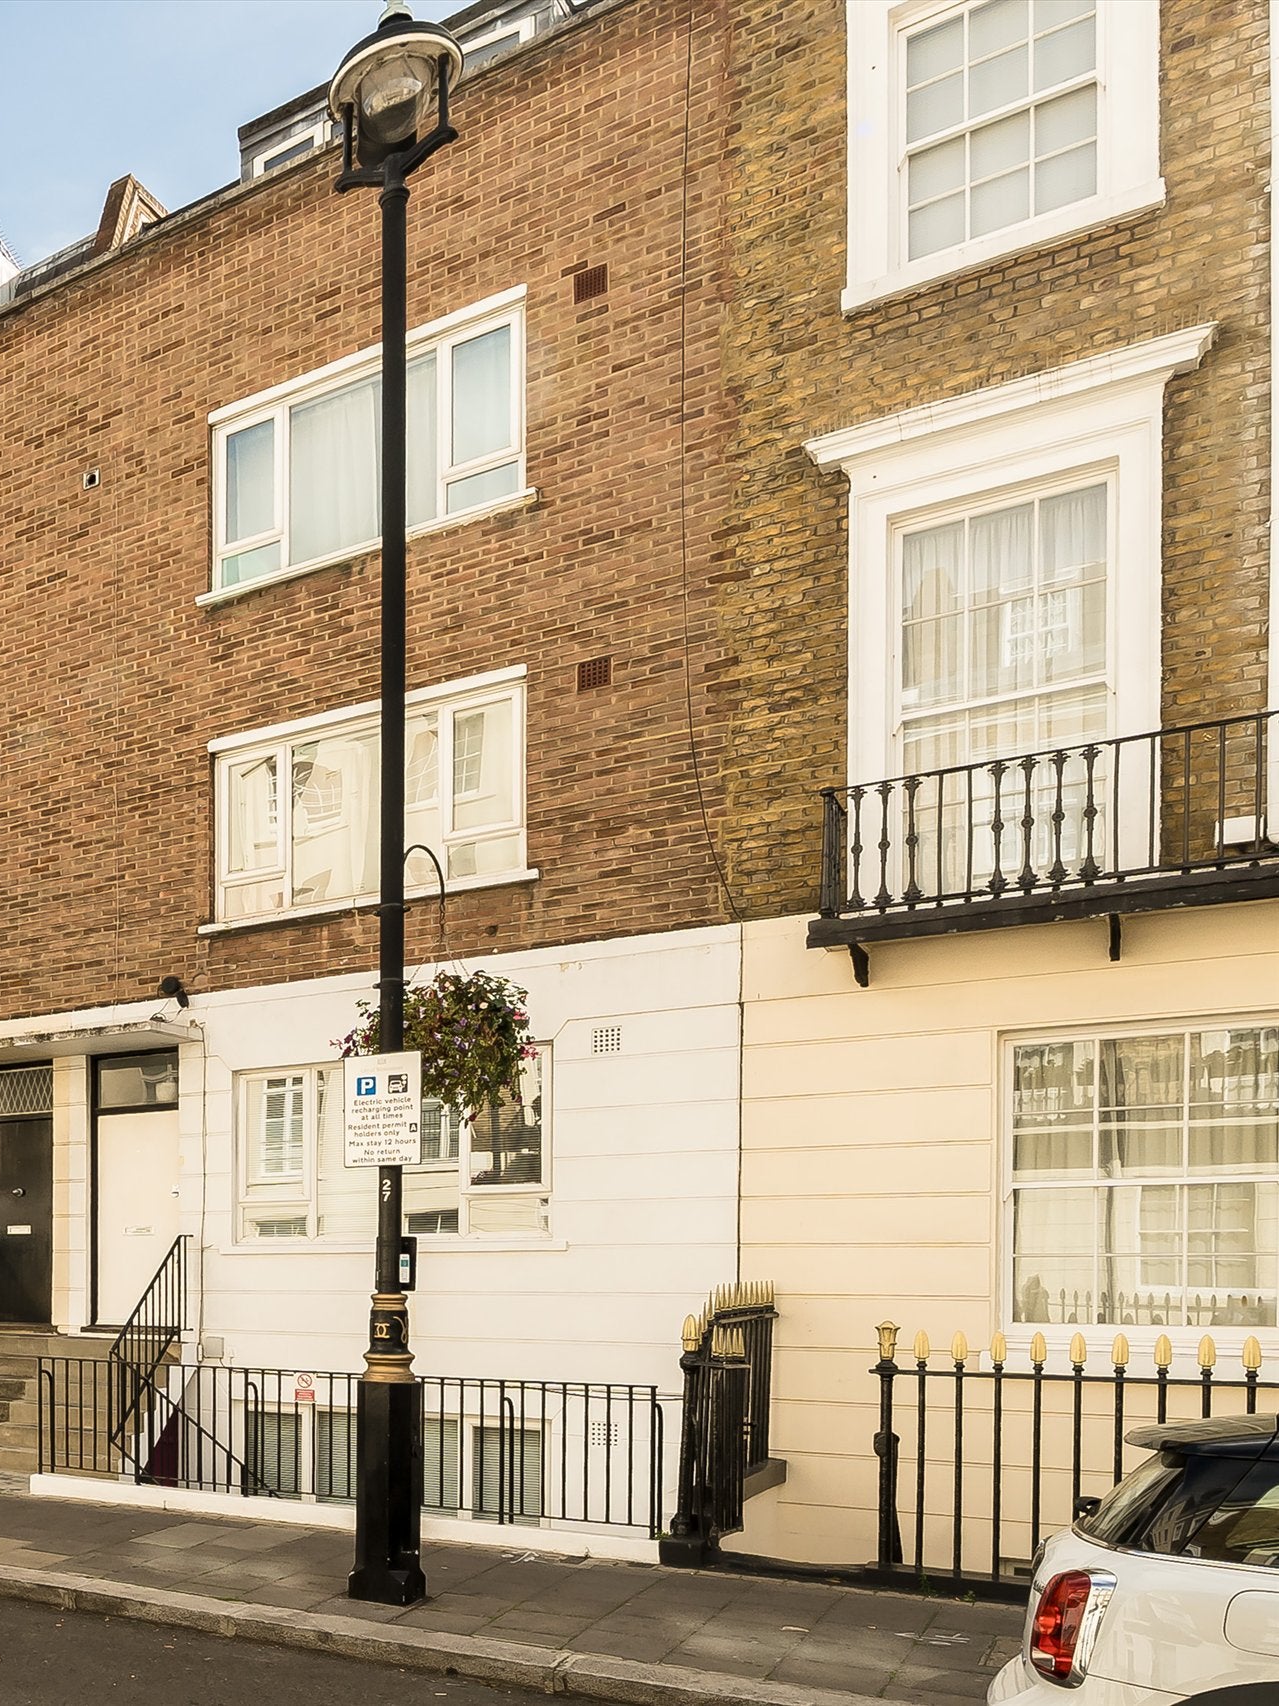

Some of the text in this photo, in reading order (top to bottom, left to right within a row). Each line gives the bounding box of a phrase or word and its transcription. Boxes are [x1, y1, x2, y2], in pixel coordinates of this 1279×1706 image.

[351, 1104, 413, 1113] recharging point
[382, 1121, 407, 1129] permit
[399, 1155, 413, 1163] day
